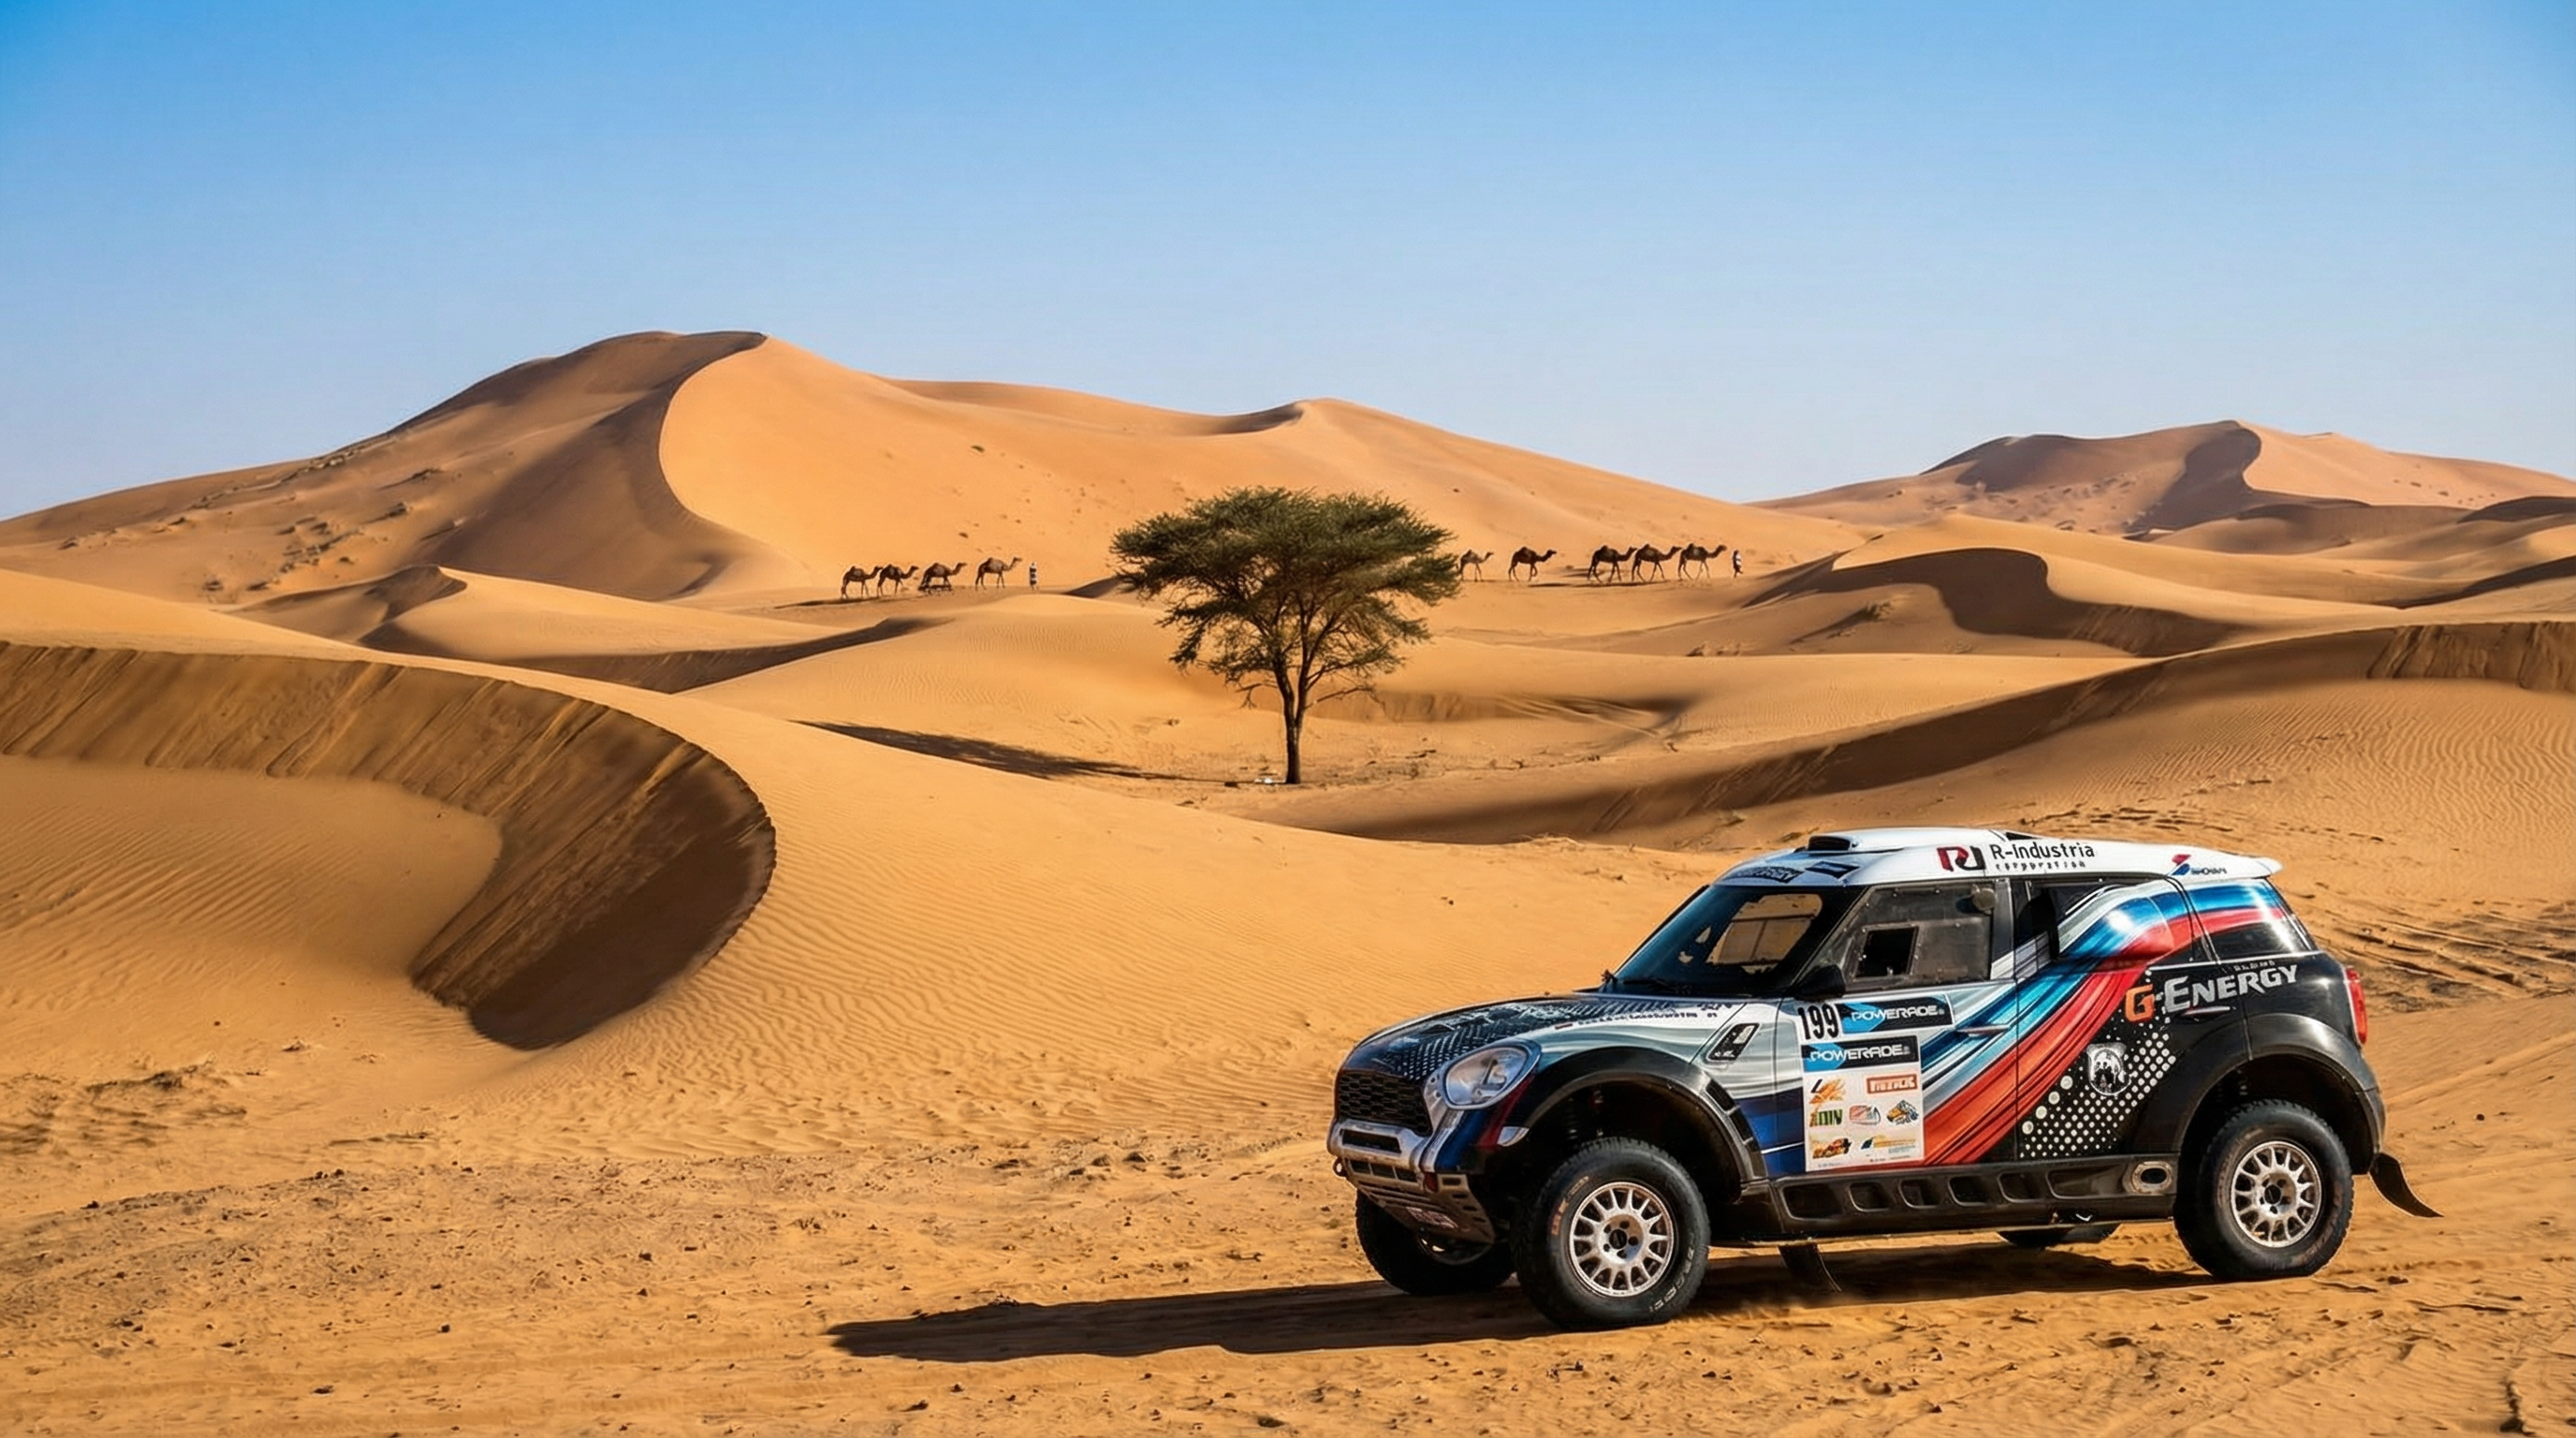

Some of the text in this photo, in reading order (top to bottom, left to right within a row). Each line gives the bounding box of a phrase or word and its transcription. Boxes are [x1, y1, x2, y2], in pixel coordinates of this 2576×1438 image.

[1989, 842, 2095, 860] R-Industria
[1797, 1004, 1840, 1040] 199
[1851, 1005, 1939, 1021] POWERADE
[1809, 1044, 1904, 1062] POWERADE
